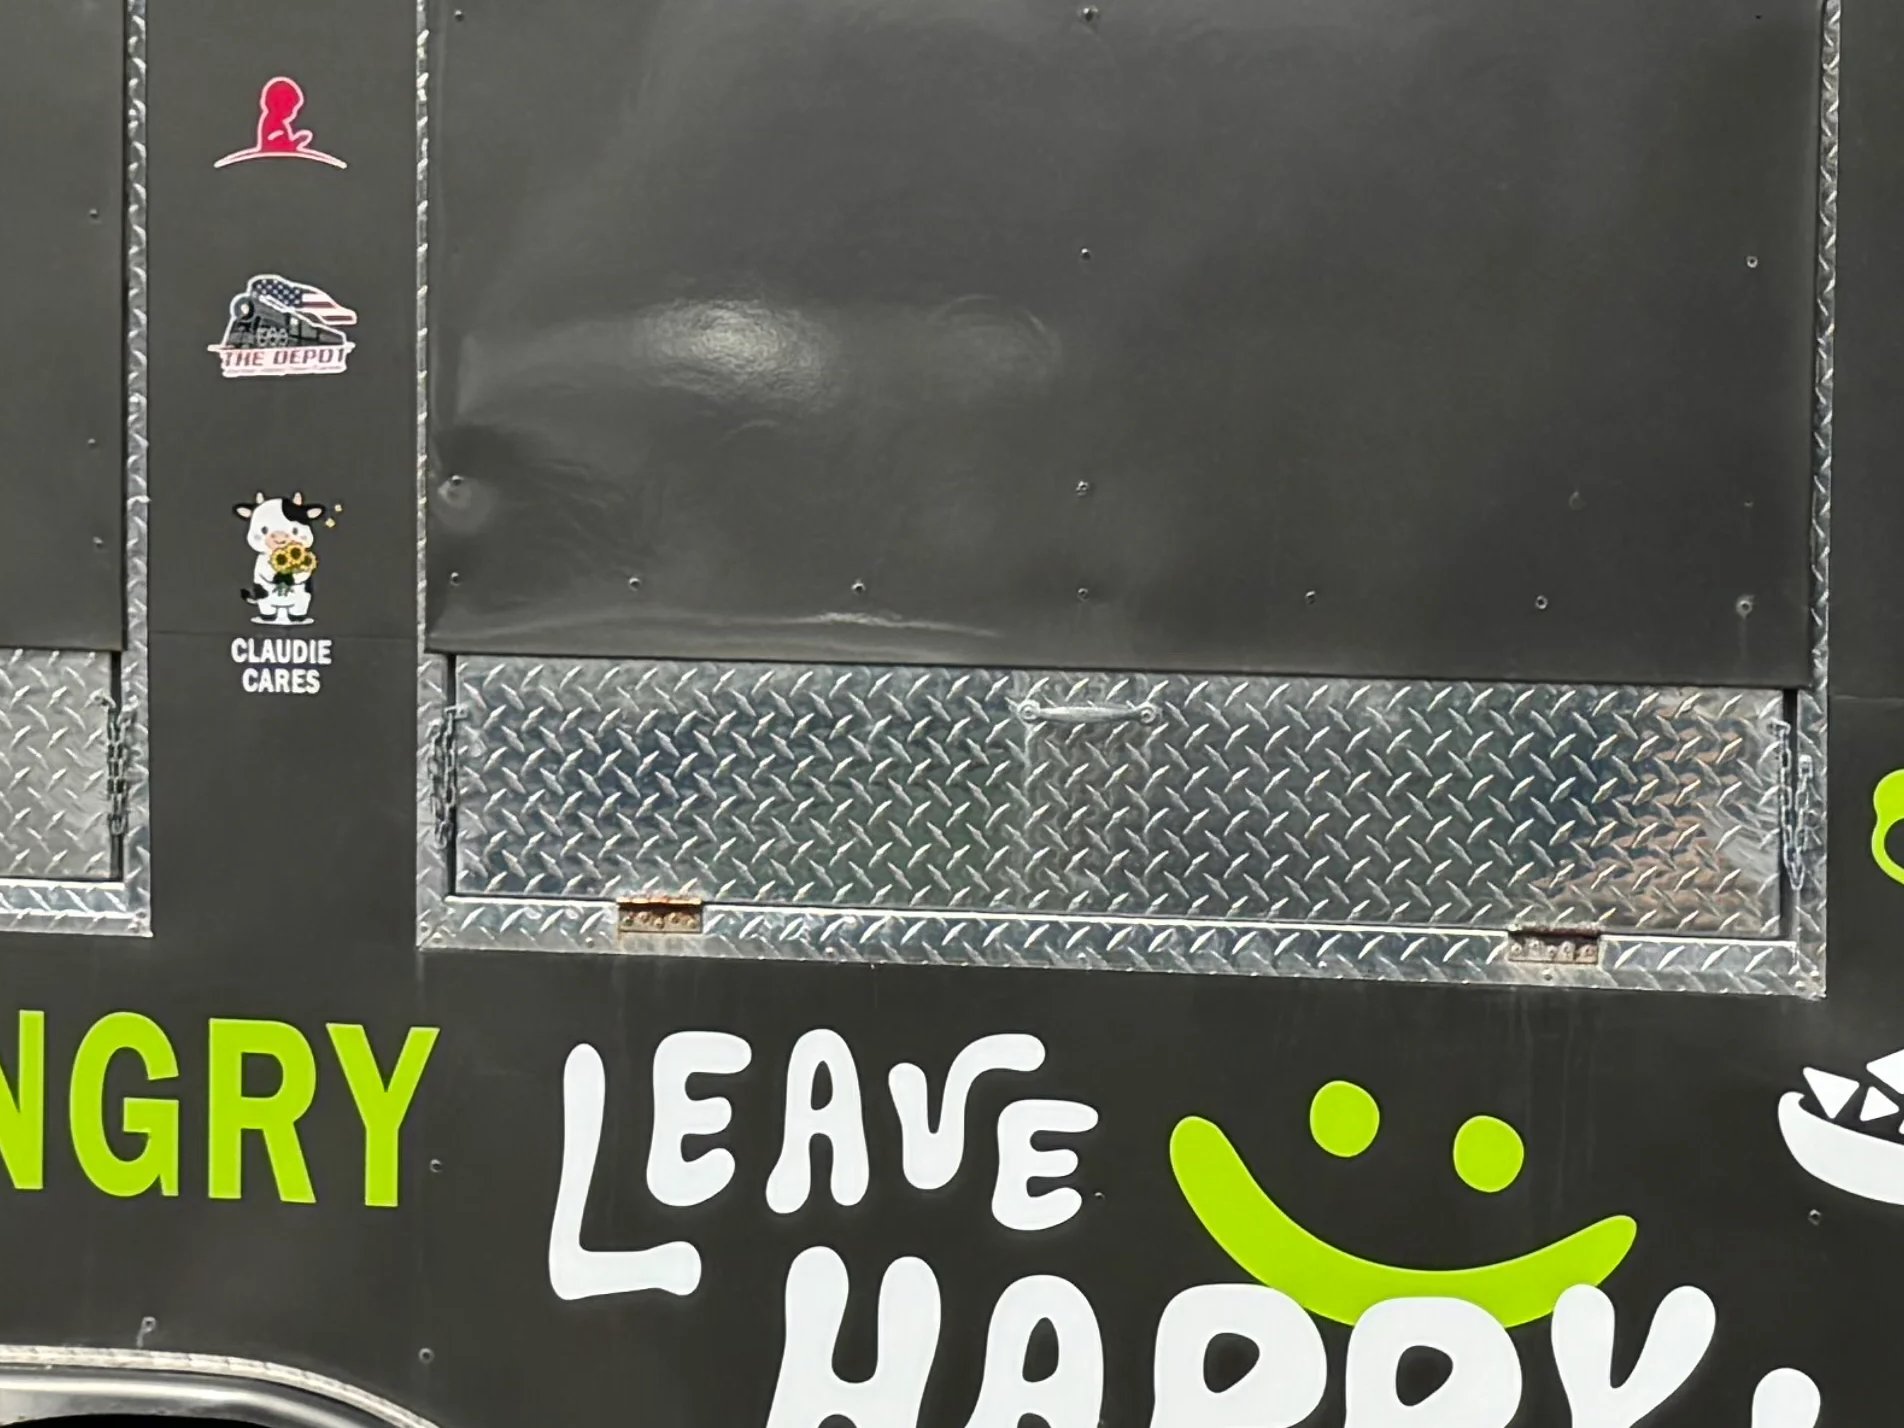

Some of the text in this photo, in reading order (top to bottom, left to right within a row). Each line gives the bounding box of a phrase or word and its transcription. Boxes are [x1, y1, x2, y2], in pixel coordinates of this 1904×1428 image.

[223, 352, 264, 367] THE
[232, 638, 331, 664] CLAUDIE
[243, 668, 320, 693] CARES
[549, 1029, 1098, 1300] LEAVE
